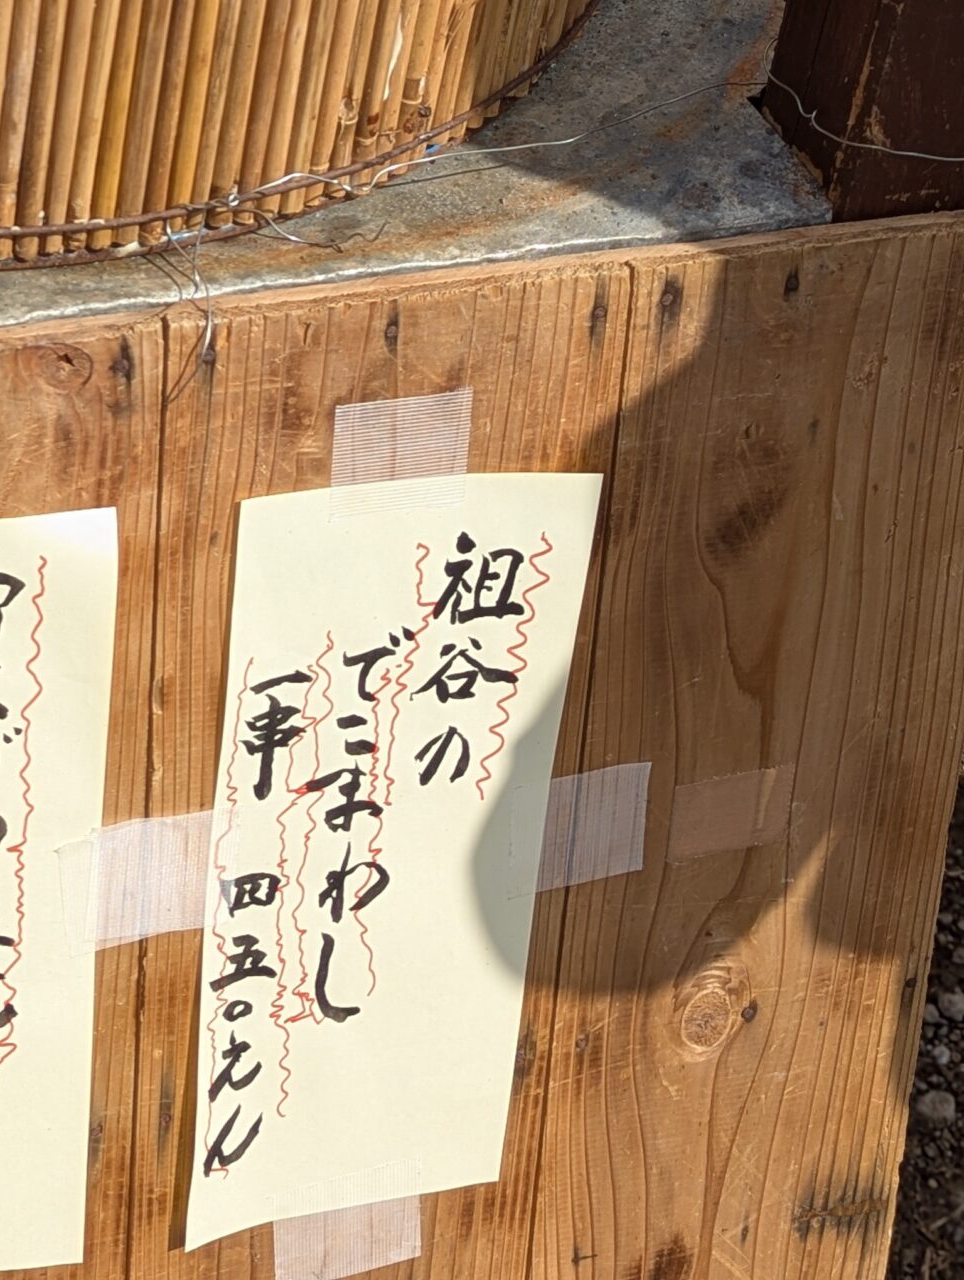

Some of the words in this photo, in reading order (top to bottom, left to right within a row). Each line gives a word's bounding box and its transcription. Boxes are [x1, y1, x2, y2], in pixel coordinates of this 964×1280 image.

[410, 530, 525, 787] 祖谷の
[304, 625, 415, 1023] でこまわし
